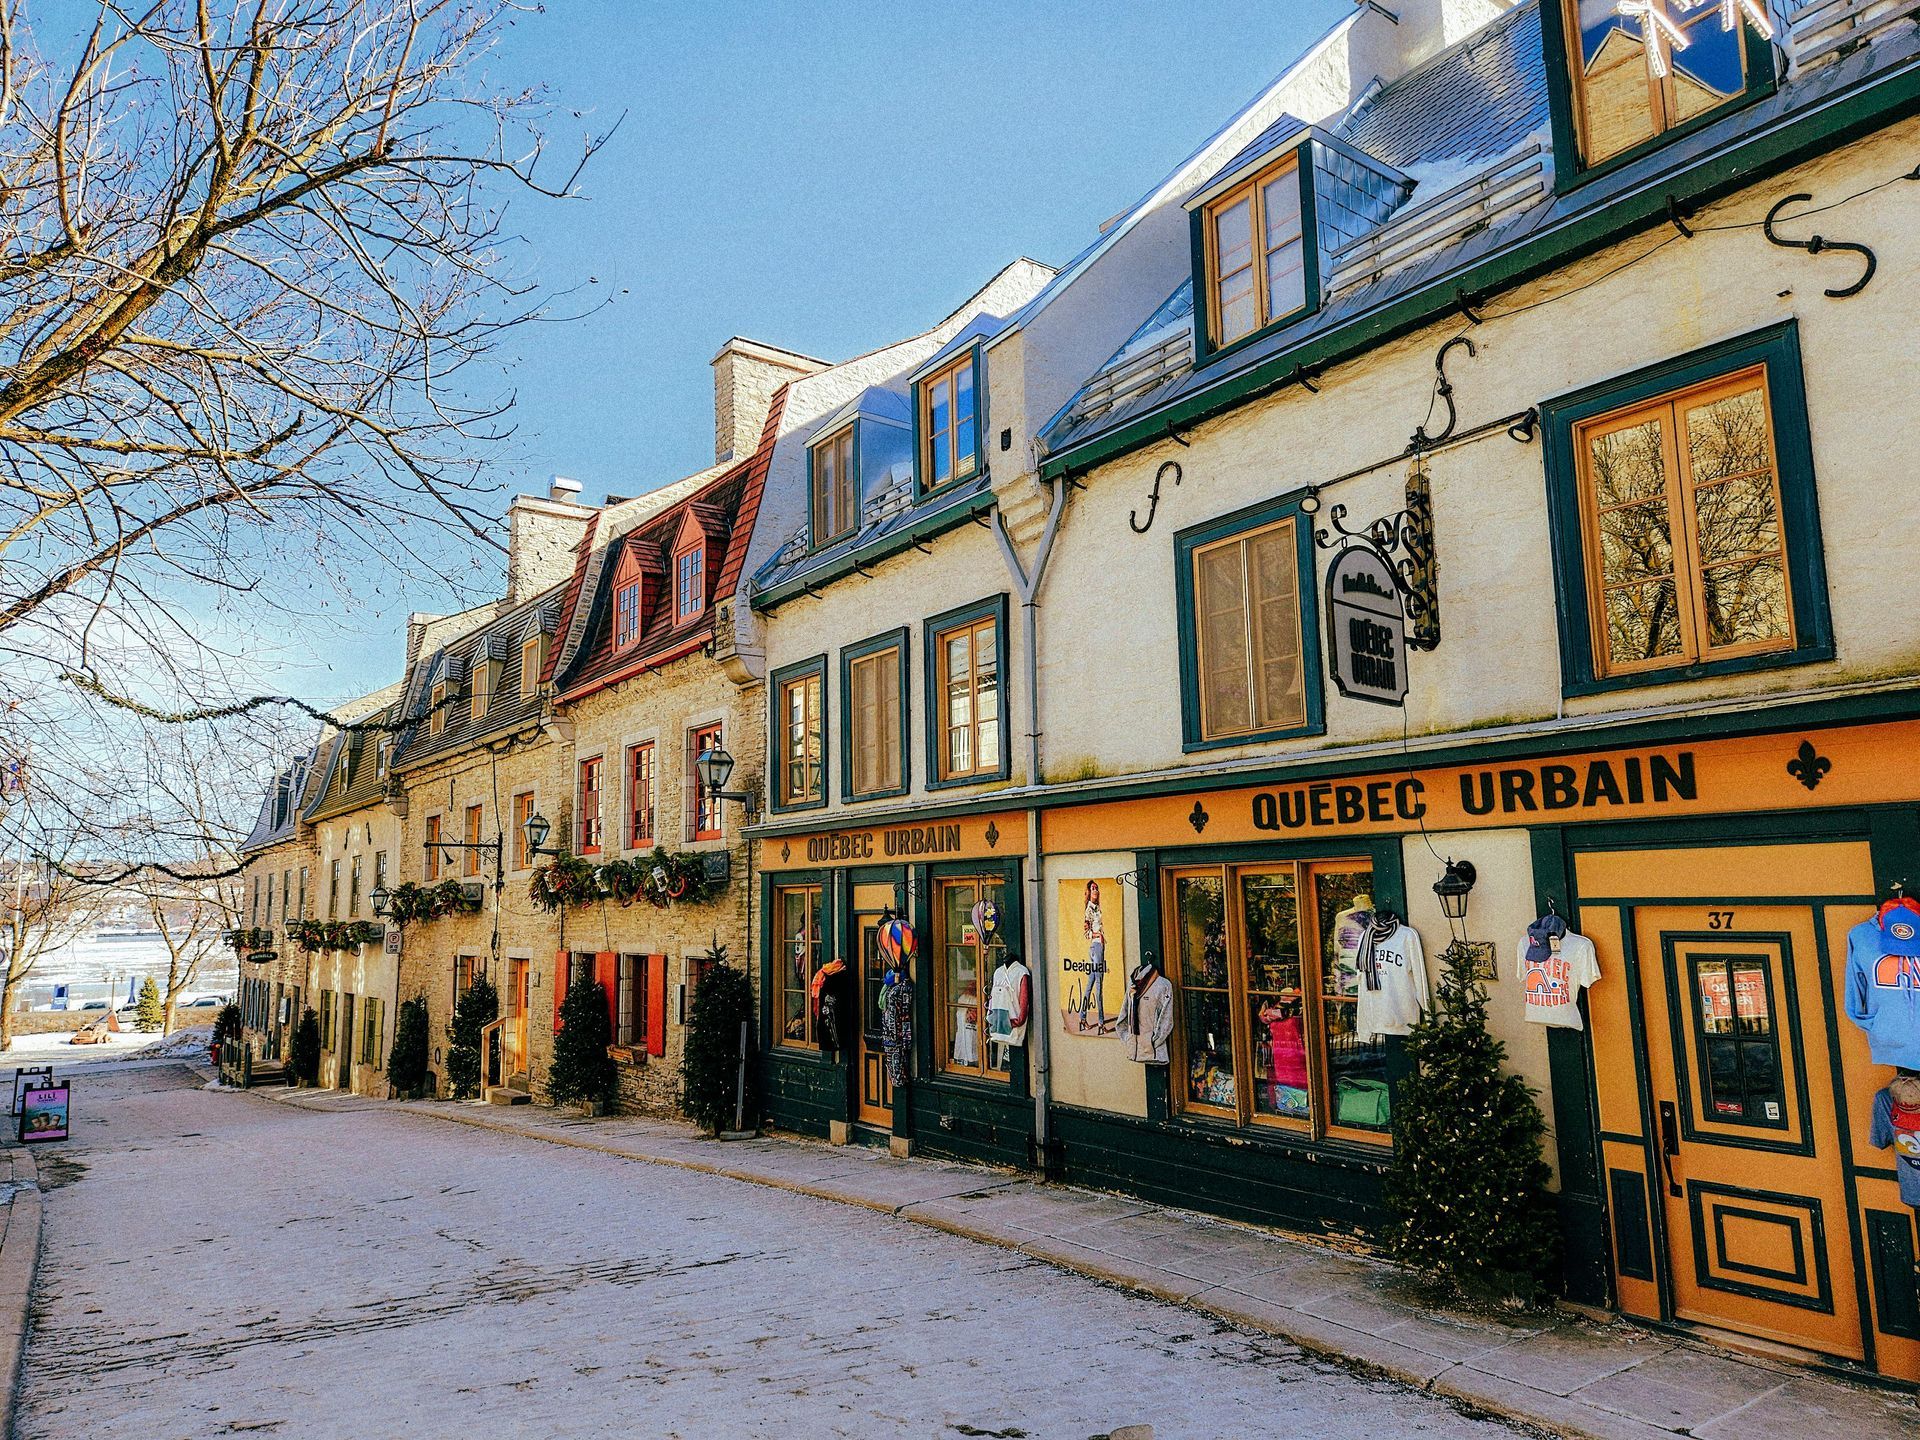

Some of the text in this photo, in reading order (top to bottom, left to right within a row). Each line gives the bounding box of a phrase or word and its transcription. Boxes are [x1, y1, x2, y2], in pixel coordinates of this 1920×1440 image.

[1351, 653, 1397, 691] URBAIN
[1460, 751, 1698, 816] URBAIN
[884, 824, 961, 857] URBAIN
[1707, 911, 1735, 930] 37
[1063, 958, 1107, 976] Desigual
[1067, 977, 1097, 1014] Wow
[1711, 981, 1757, 993] OUERT
[1720, 995, 1753, 1006] OEN
